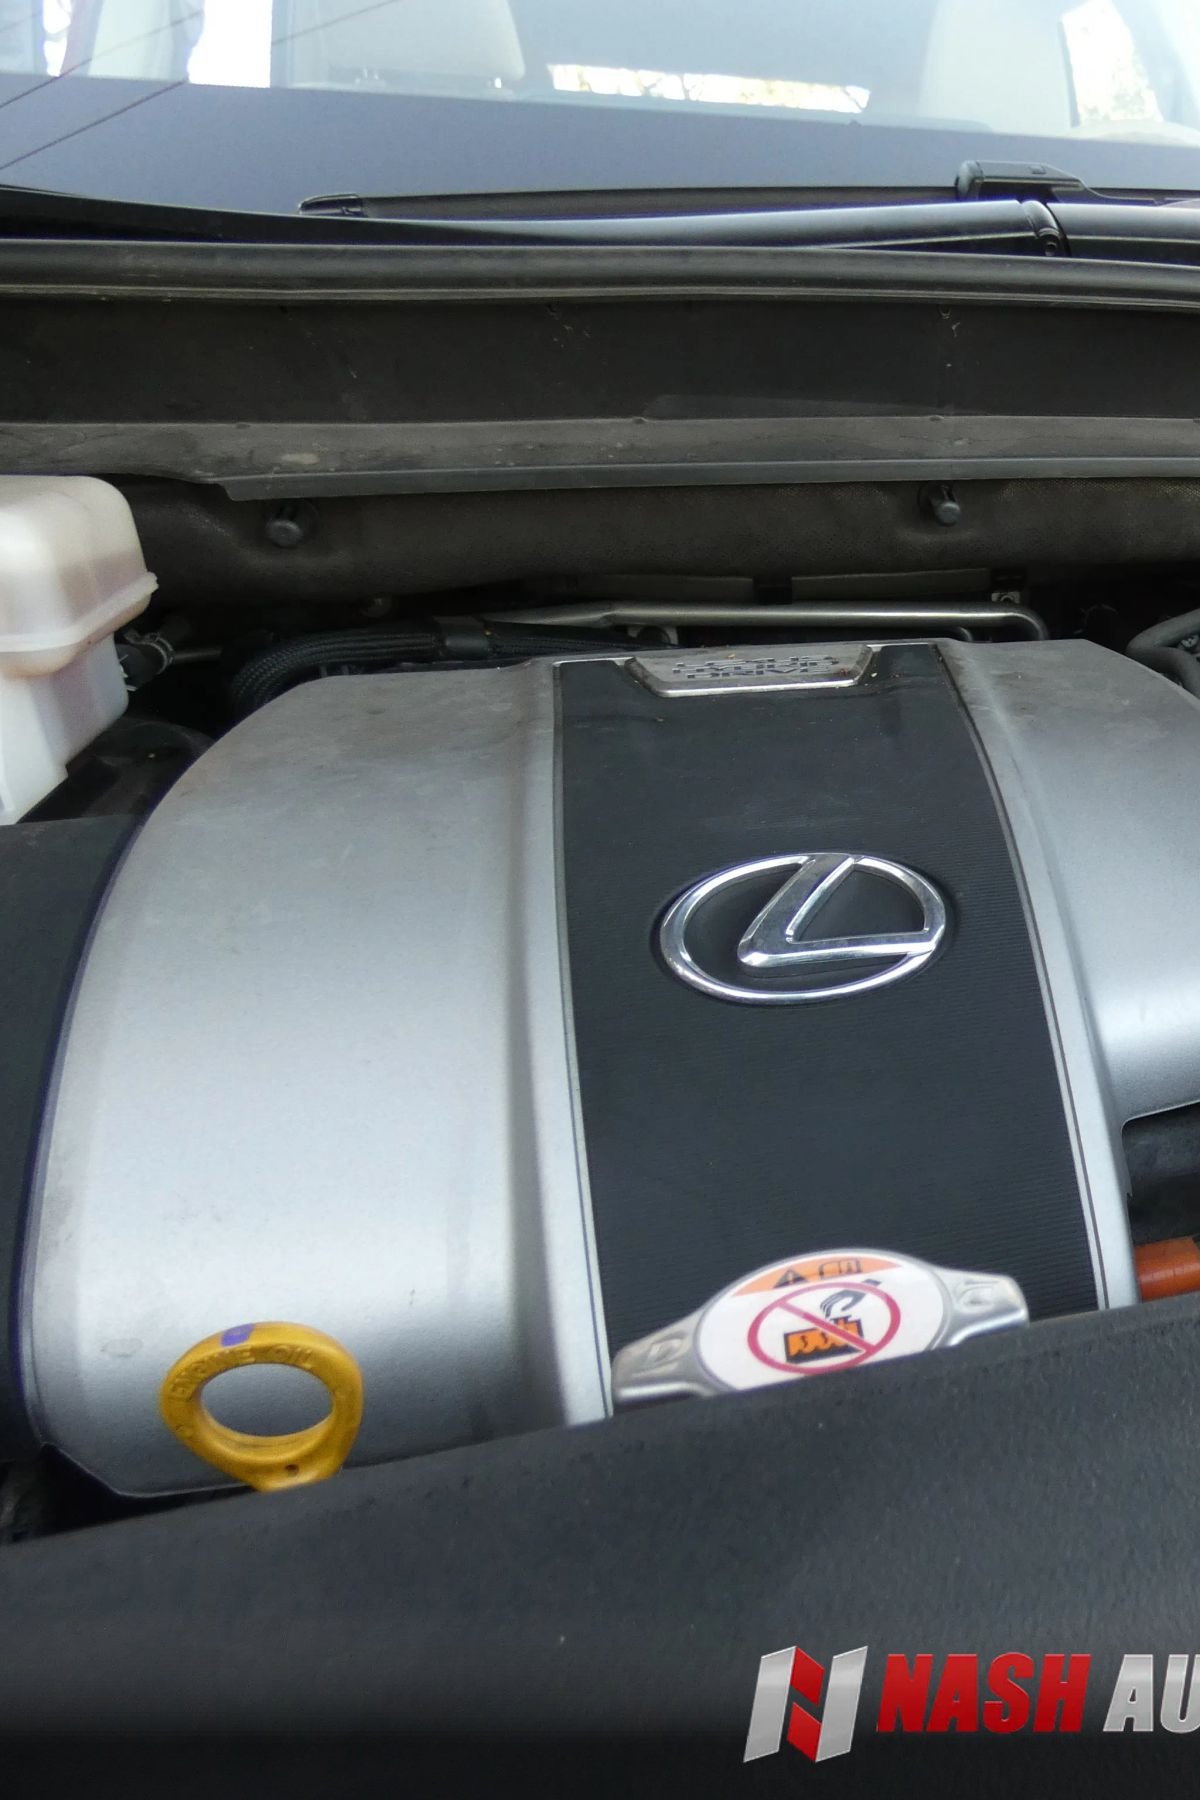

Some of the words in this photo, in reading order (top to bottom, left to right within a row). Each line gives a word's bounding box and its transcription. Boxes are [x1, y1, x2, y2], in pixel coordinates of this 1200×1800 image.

[686, 665, 831, 678] DRIVE
[168, 1346, 256, 1401] ENGINE
[268, 1342, 314, 1370] OIL
